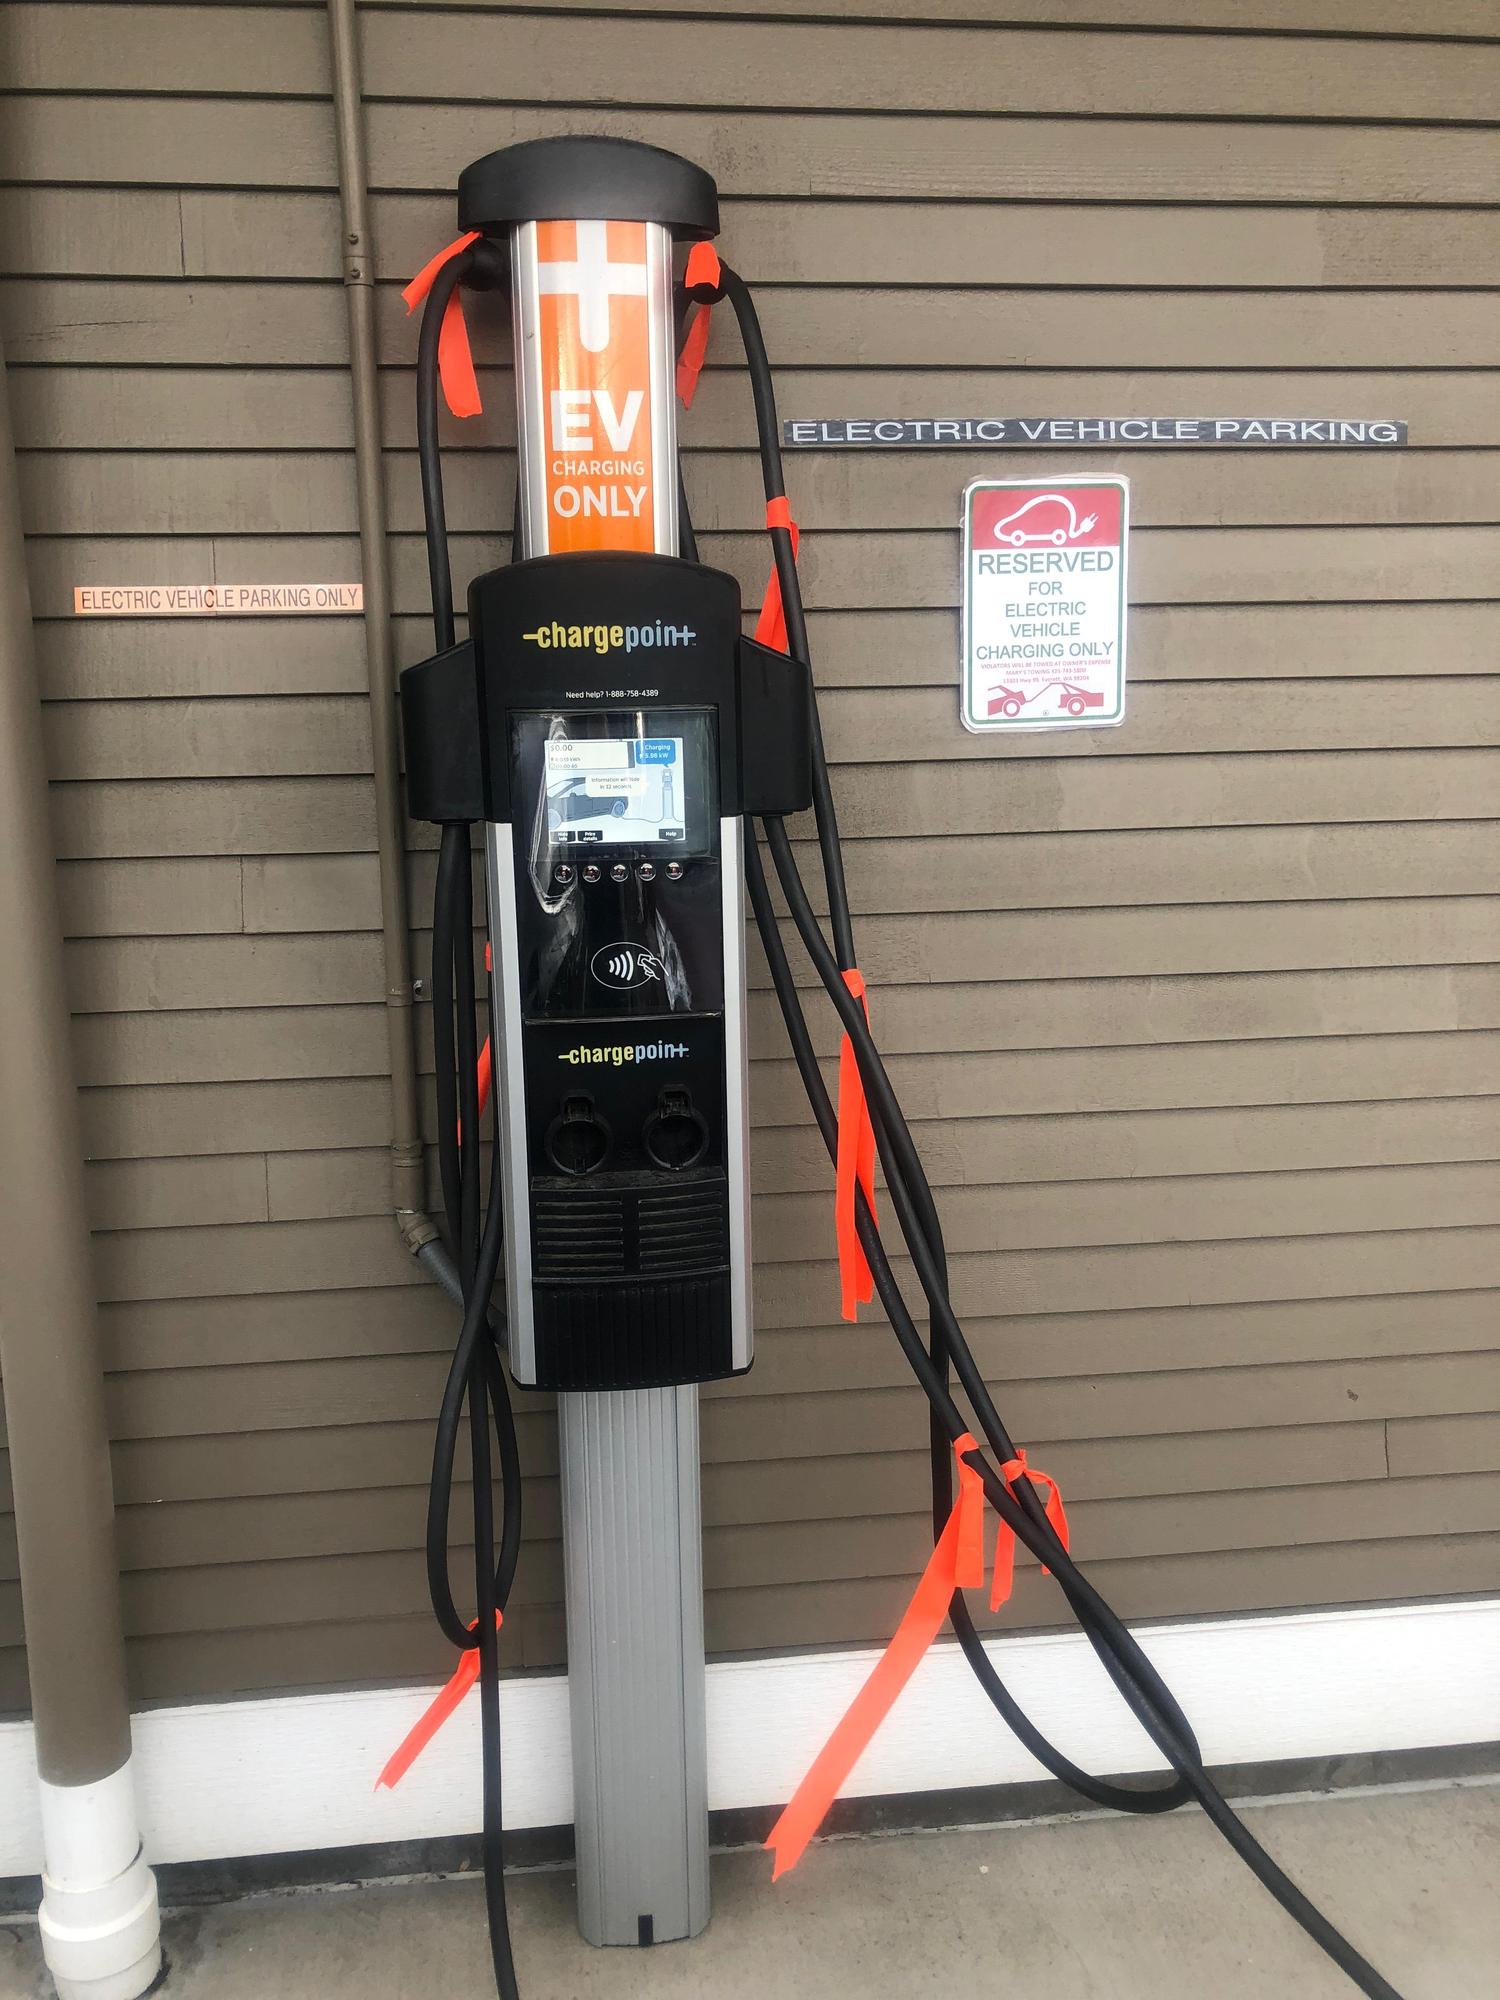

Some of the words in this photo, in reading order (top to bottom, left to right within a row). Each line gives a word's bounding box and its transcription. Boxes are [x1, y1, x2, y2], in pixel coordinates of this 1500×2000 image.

[550, 389, 645, 452] EV
[791, 420, 1005, 443] ELECTRIC
[1018, 420, 1200, 441] VEHICLE
[1215, 420, 1399, 443] PARKING
[552, 460, 645, 476] CHARGING
[553, 485, 648, 518] ONLY
[978, 550, 1114, 575] RESERVED
[82, 590, 161, 609] ELECTRIC
[165, 589, 234, 609] VEHICLE
[240, 588, 310, 607] PARKING
[315, 587, 358, 607] ONLY
[1028, 581, 1063, 596] FOR
[1005, 601, 1086, 617] ELECTRIC
[523, 619, 697, 654] chargepoint
[1010, 622, 1080, 638] VEHICLE
[976, 643, 1064, 660] CHARGING
[1069, 641, 1114, 657] ONLY
[585, 690, 604, 699] help?
[605, 689, 659, 698] 1-888-758-4389
[558, 1040, 690, 1066] chargepoint
